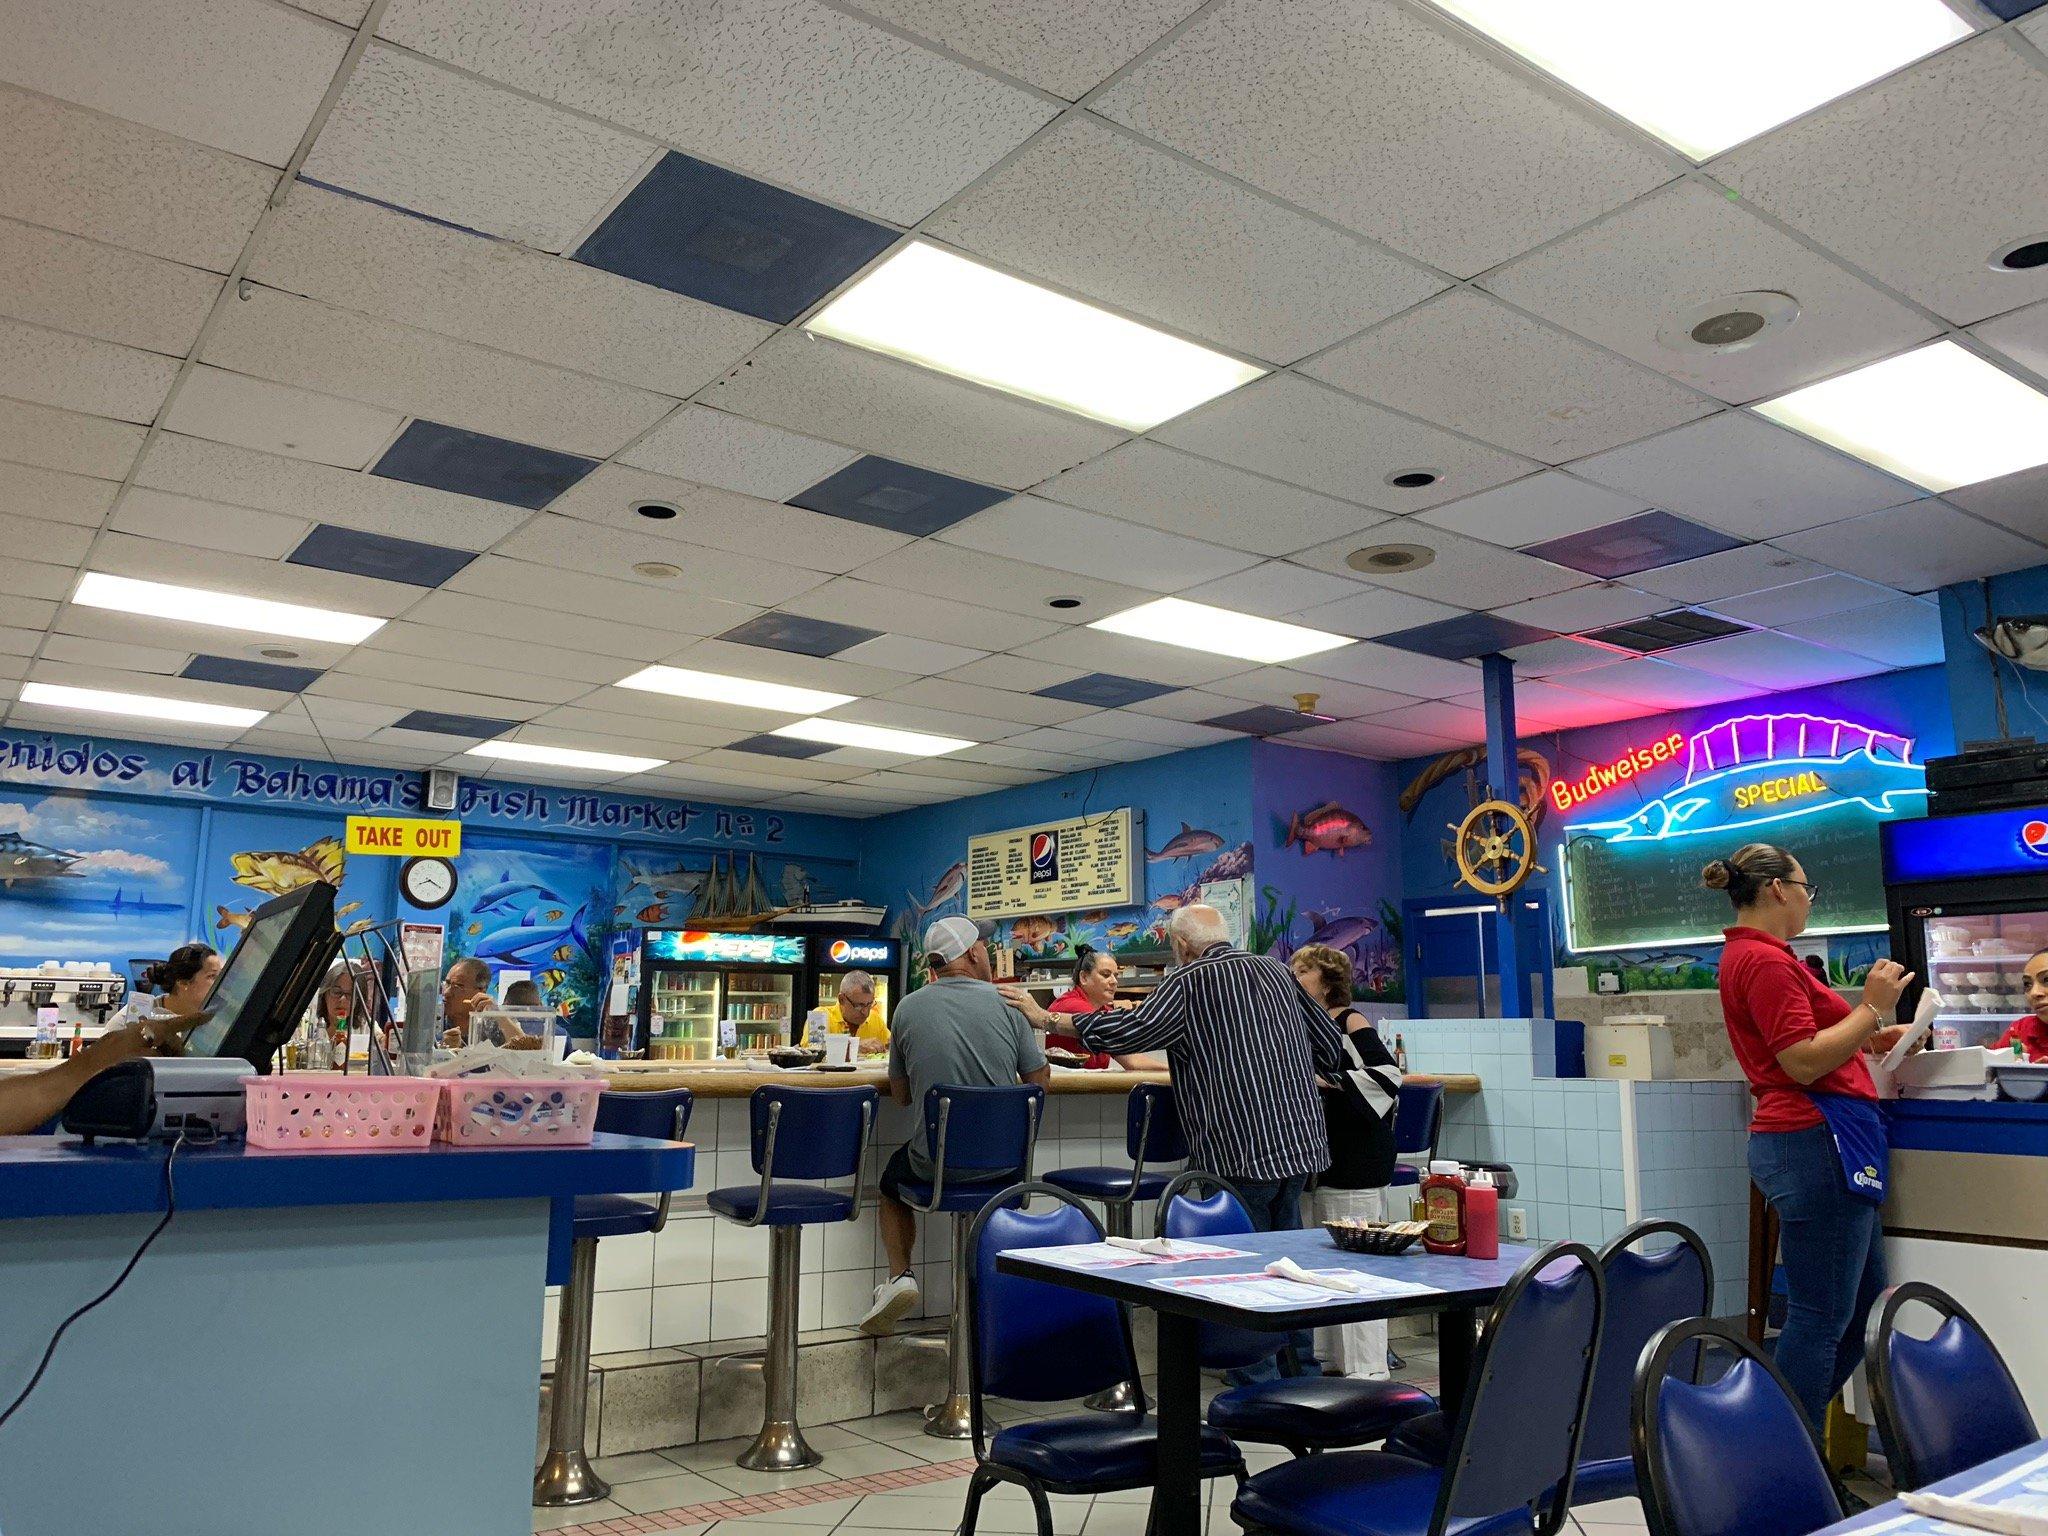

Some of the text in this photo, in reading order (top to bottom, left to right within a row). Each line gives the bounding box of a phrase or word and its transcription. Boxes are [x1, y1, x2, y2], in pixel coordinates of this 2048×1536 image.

[1552, 733, 1683, 810] Budweiser
[172, 755, 214, 788] al
[226, 760, 422, 806] Bahama's
[460, 783, 549, 819] Fish
[766, 817, 784, 841] 2
[1735, 771, 1827, 808] SPECIAL
[356, 826, 451, 848] TAKE OUT
[1033, 868, 1052, 879] pepsi
[851, 946, 888, 961] pepsi
